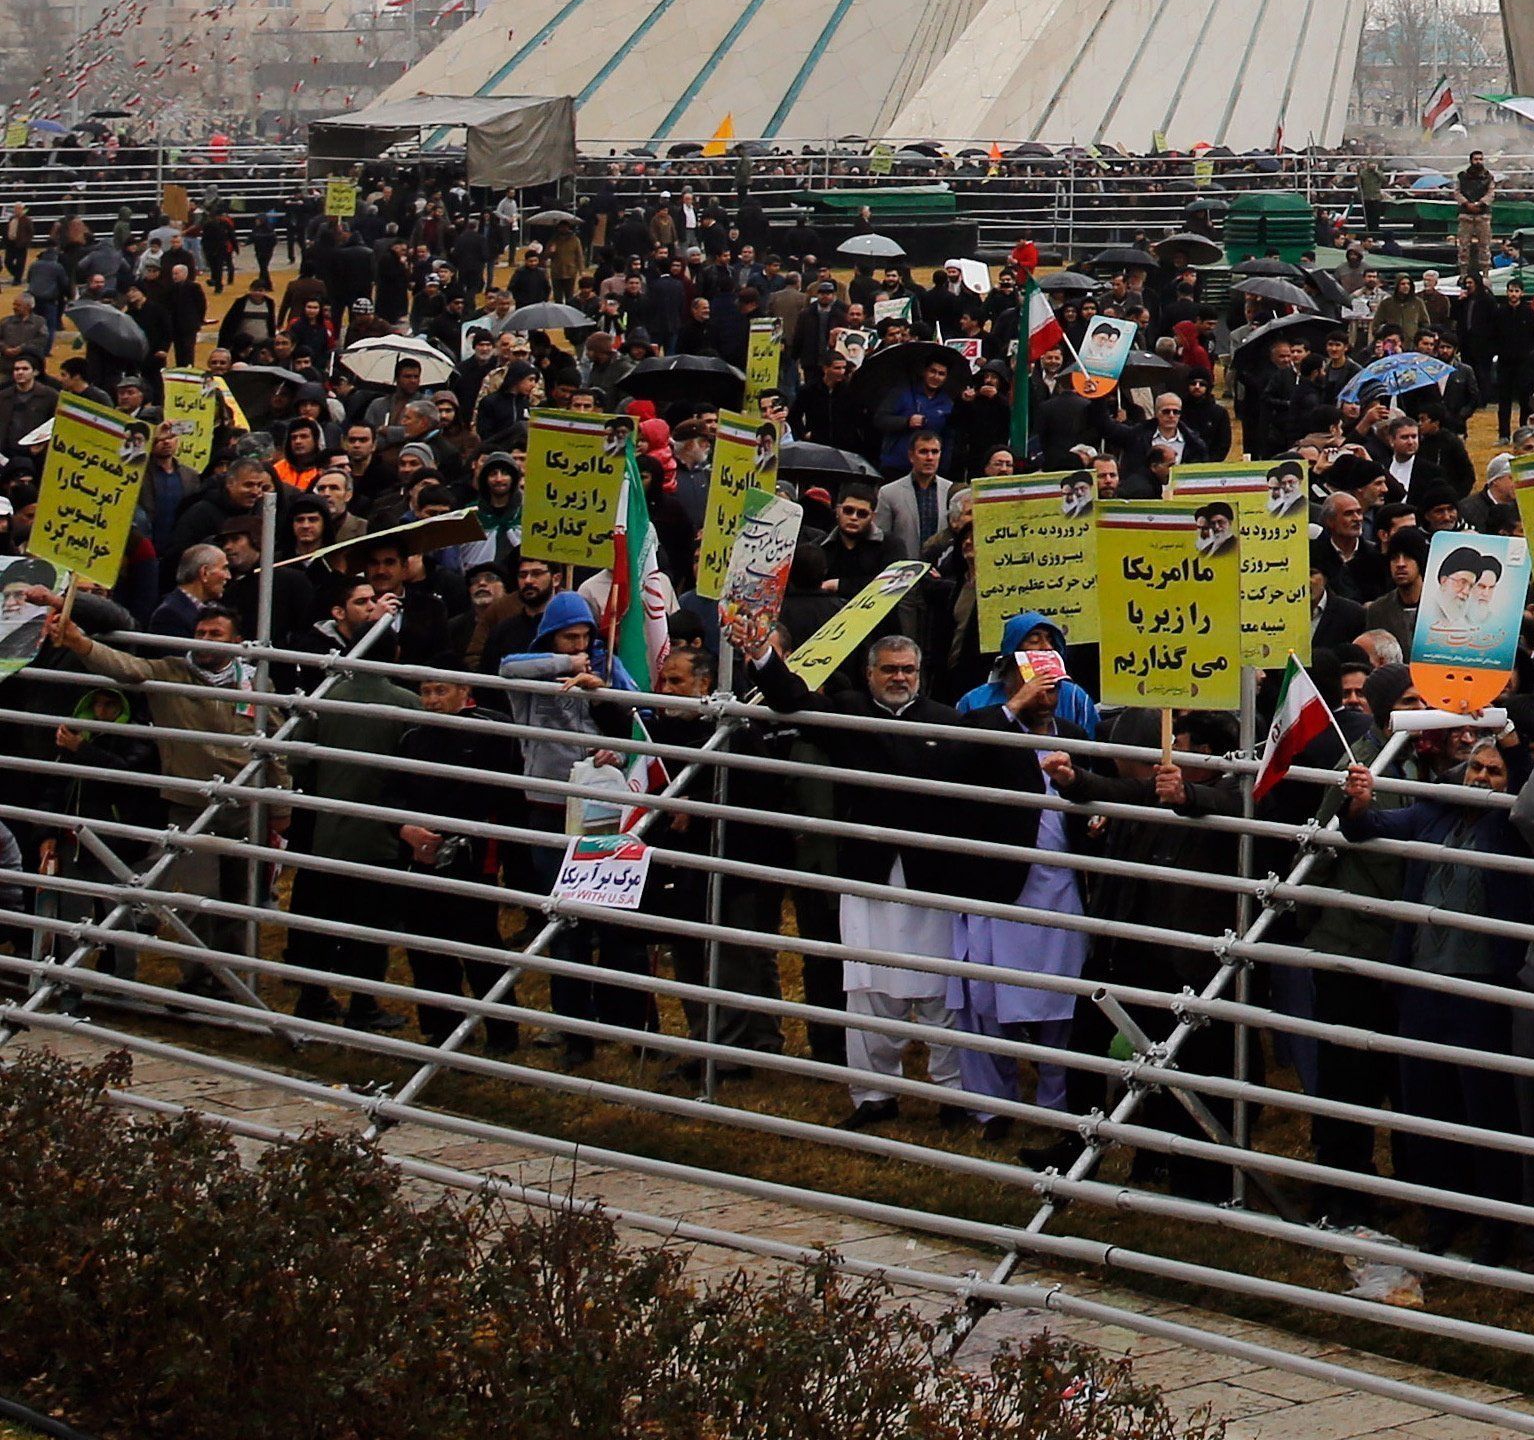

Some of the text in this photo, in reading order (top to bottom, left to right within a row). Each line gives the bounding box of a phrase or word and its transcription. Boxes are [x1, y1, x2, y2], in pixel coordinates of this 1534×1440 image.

[67, 445, 99, 470] عرصه
[100, 460, 119, 476] همه
[545, 450, 614, 477] ما امریکا
[122, 470, 139, 486] در
[545, 482, 607, 512] را زیر پا
[44, 520, 111, 560] خواهیم کرد
[531, 517, 614, 545] می گذاریم
[985, 522, 1089, 544] در ورود به ۴۰ سالگی
[994, 550, 1083, 568] پیروزی انقلاب
[1122, 555, 1214, 590] ما امریکا
[980, 574, 1098, 599] این حرکت عظیم مردمی
[1060, 602, 1082, 620] شبیه
[1127, 599, 1211, 635] را زیر پا
[1113, 644, 1228, 679] می گذاریم
[592, 871, 613, 890] بر
[614, 865, 641, 892] مرگ
[577, 890, 605, 903] WITH
